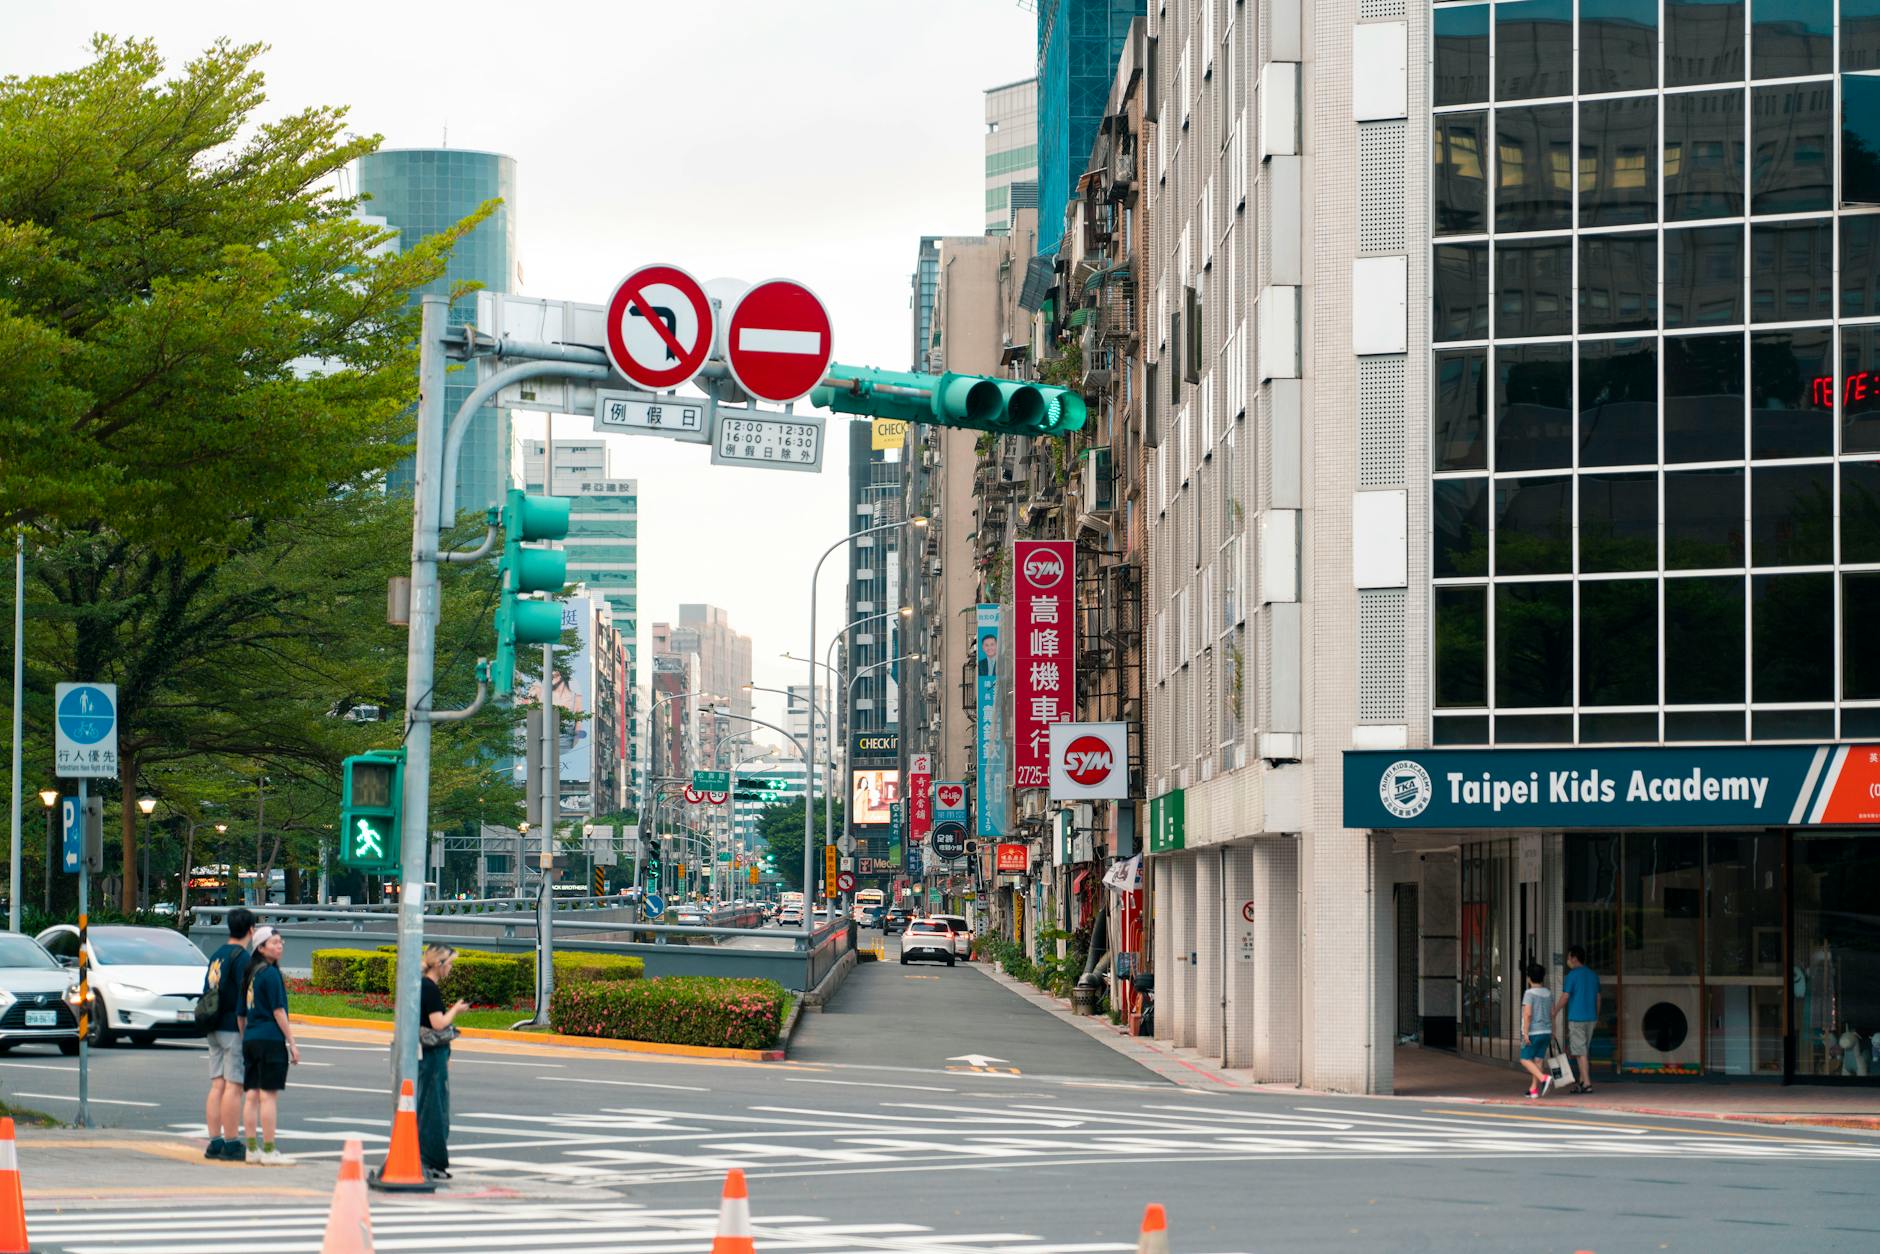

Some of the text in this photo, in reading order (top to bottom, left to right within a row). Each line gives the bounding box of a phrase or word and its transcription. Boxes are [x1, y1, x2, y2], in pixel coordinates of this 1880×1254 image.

[610, 403, 695, 427] 例假日
[727, 421, 763, 433] 12:00
[778, 425, 813, 437] 12:30
[726, 432, 762, 444] 16:00
[778, 436, 812, 448] 16:30
[725, 443, 812, 461] 例假日除外
[1025, 561, 1063, 579] SYM
[562, 609, 578, 626] 挺
[1030, 595, 1059, 759] 嵩峰機車行
[860, 737, 890, 749] CHECK
[58, 749, 115, 763] 行人優先
[1063, 752, 1113, 776] SYM
[1382, 762, 1430, 792] TAIPEI KIDS ACADEMY
[1395, 780, 1416, 793] TKA
[1447, 767, 1769, 811] Taipei Kids Academy
[63, 800, 75, 842] P
